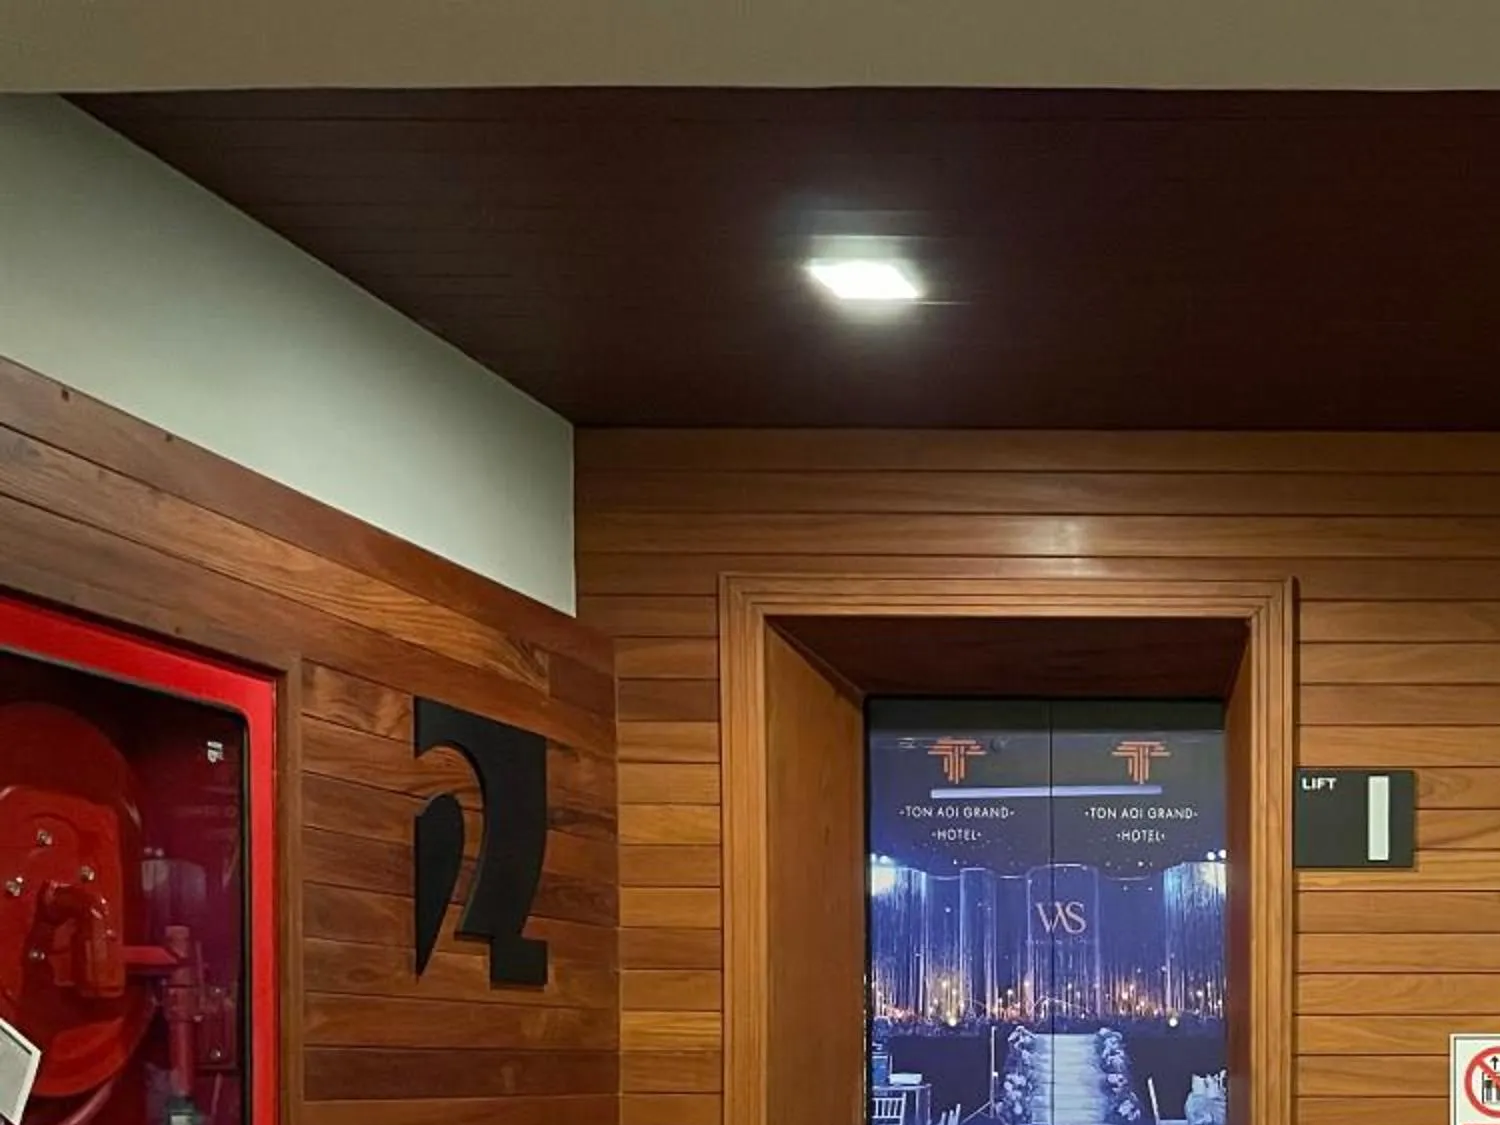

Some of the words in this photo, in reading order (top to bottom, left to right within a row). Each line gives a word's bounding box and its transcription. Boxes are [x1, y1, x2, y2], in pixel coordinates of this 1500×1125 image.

[1301, 777, 1337, 791] LIFT
[905, 805, 932, 818] TON
[963, 805, 1009, 819] GRAND
[1089, 807, 1117, 819] TON
[1147, 807, 1193, 819] GRAND
[1367, 775, 1389, 861] 1
[937, 828, 977, 841] HOTEL
[1121, 829, 1162, 842] HOTEL
